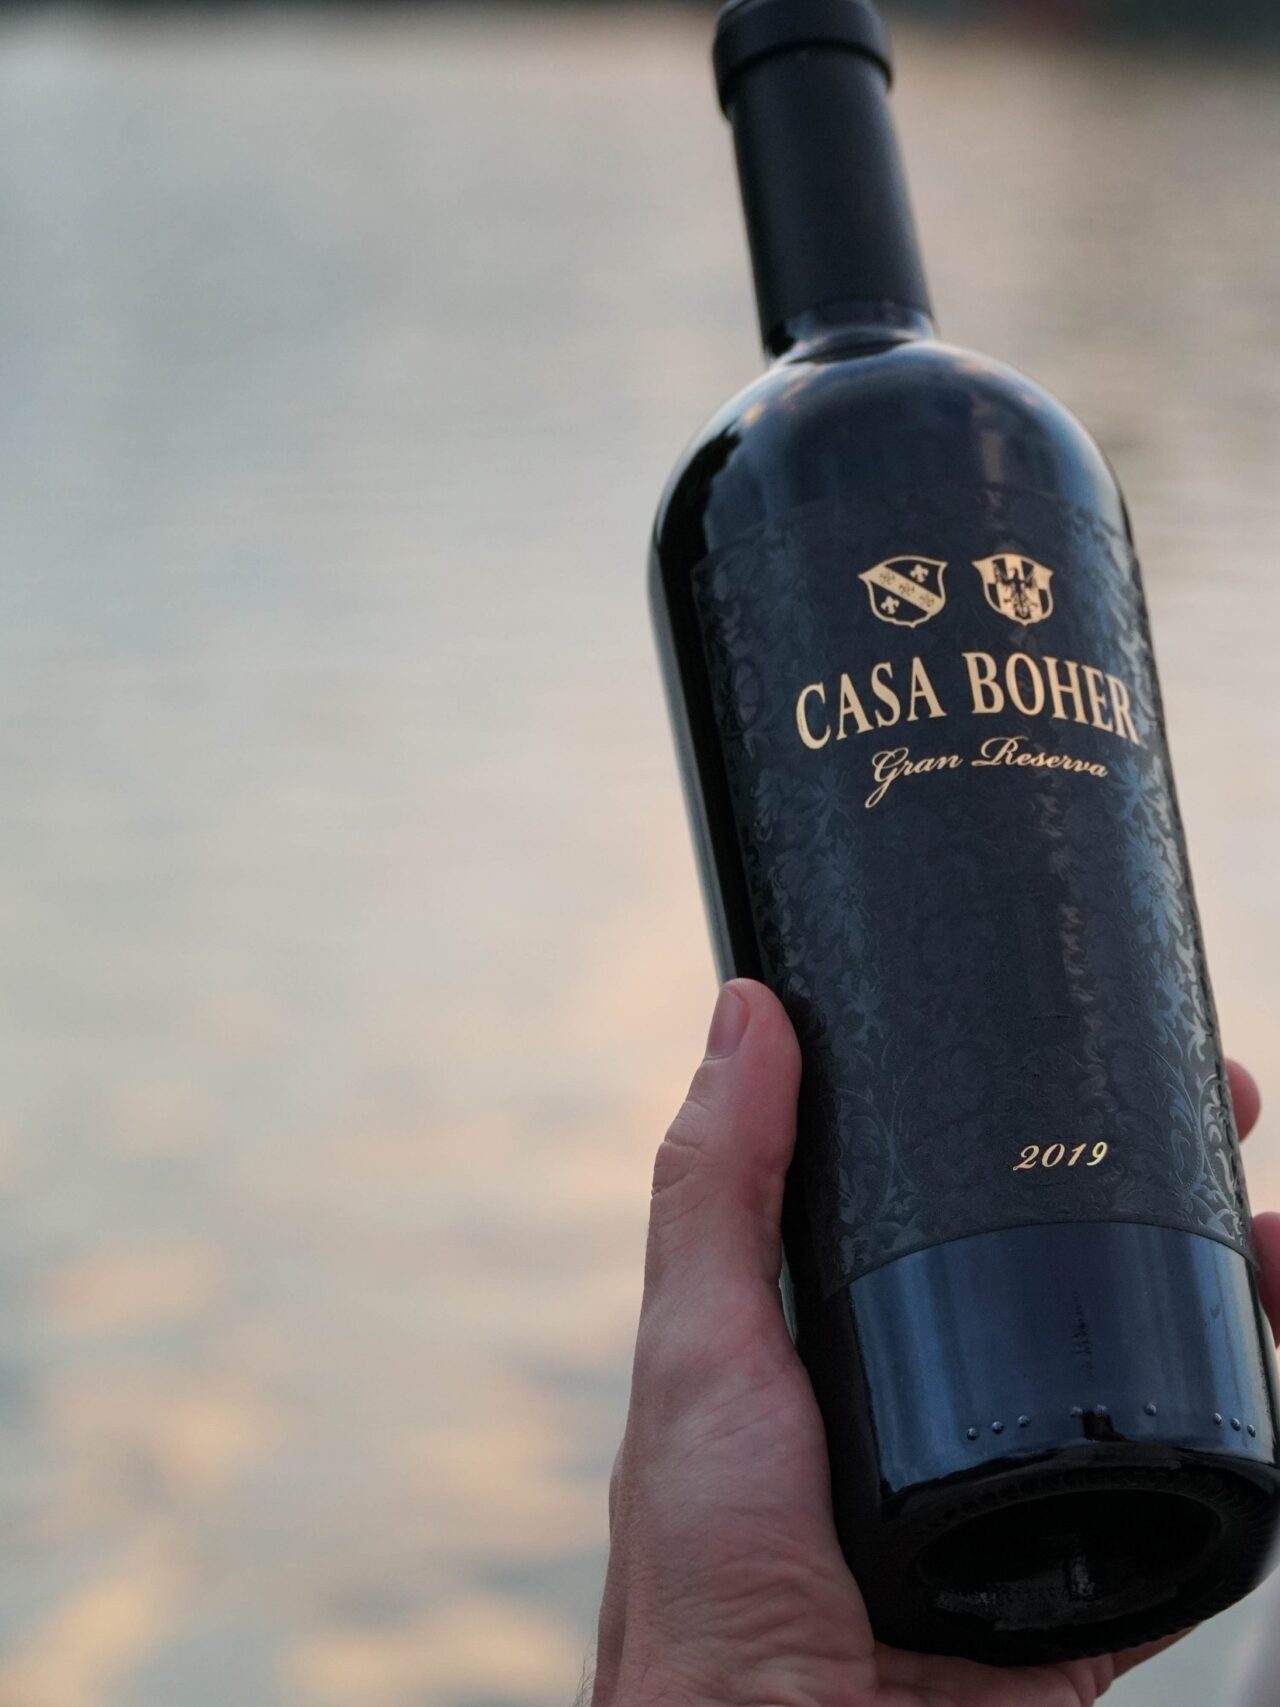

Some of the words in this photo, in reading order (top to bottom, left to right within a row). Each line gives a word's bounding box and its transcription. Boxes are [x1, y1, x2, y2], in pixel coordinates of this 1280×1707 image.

[796, 656, 947, 749] CASA
[962, 652, 1141, 746] BOHER
[865, 747, 963, 808] Gran
[971, 735, 1109, 778] Reserva
[1012, 1141, 1108, 1171] 2019
